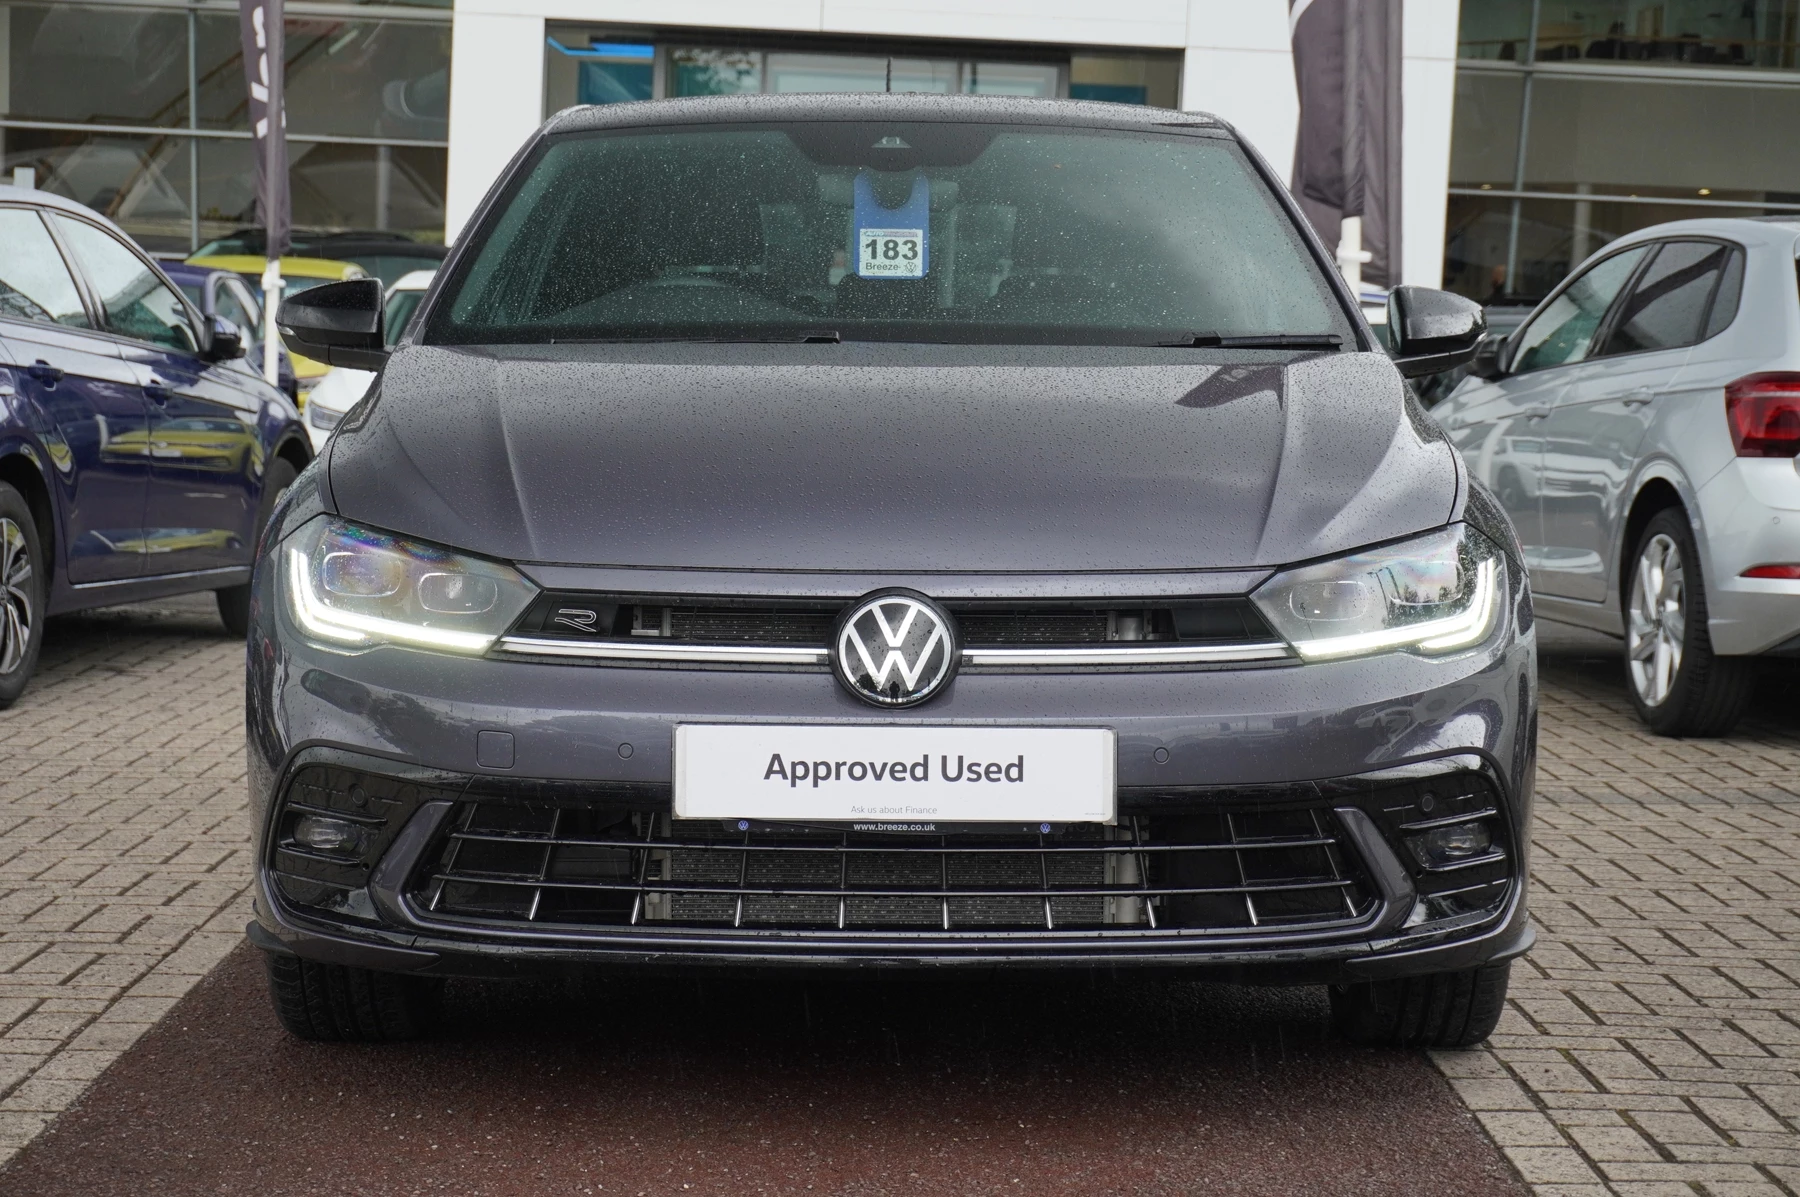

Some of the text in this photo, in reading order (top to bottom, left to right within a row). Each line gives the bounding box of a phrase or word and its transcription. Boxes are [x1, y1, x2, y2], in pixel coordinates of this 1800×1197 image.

[865, 238, 918, 261] 183
[865, 262, 899, 271] Breeze
[763, 753, 1025, 788] Approved Used
[850, 805, 938, 815] Ask us about Finance
[853, 822, 936, 832] www.breeze.co.uk
